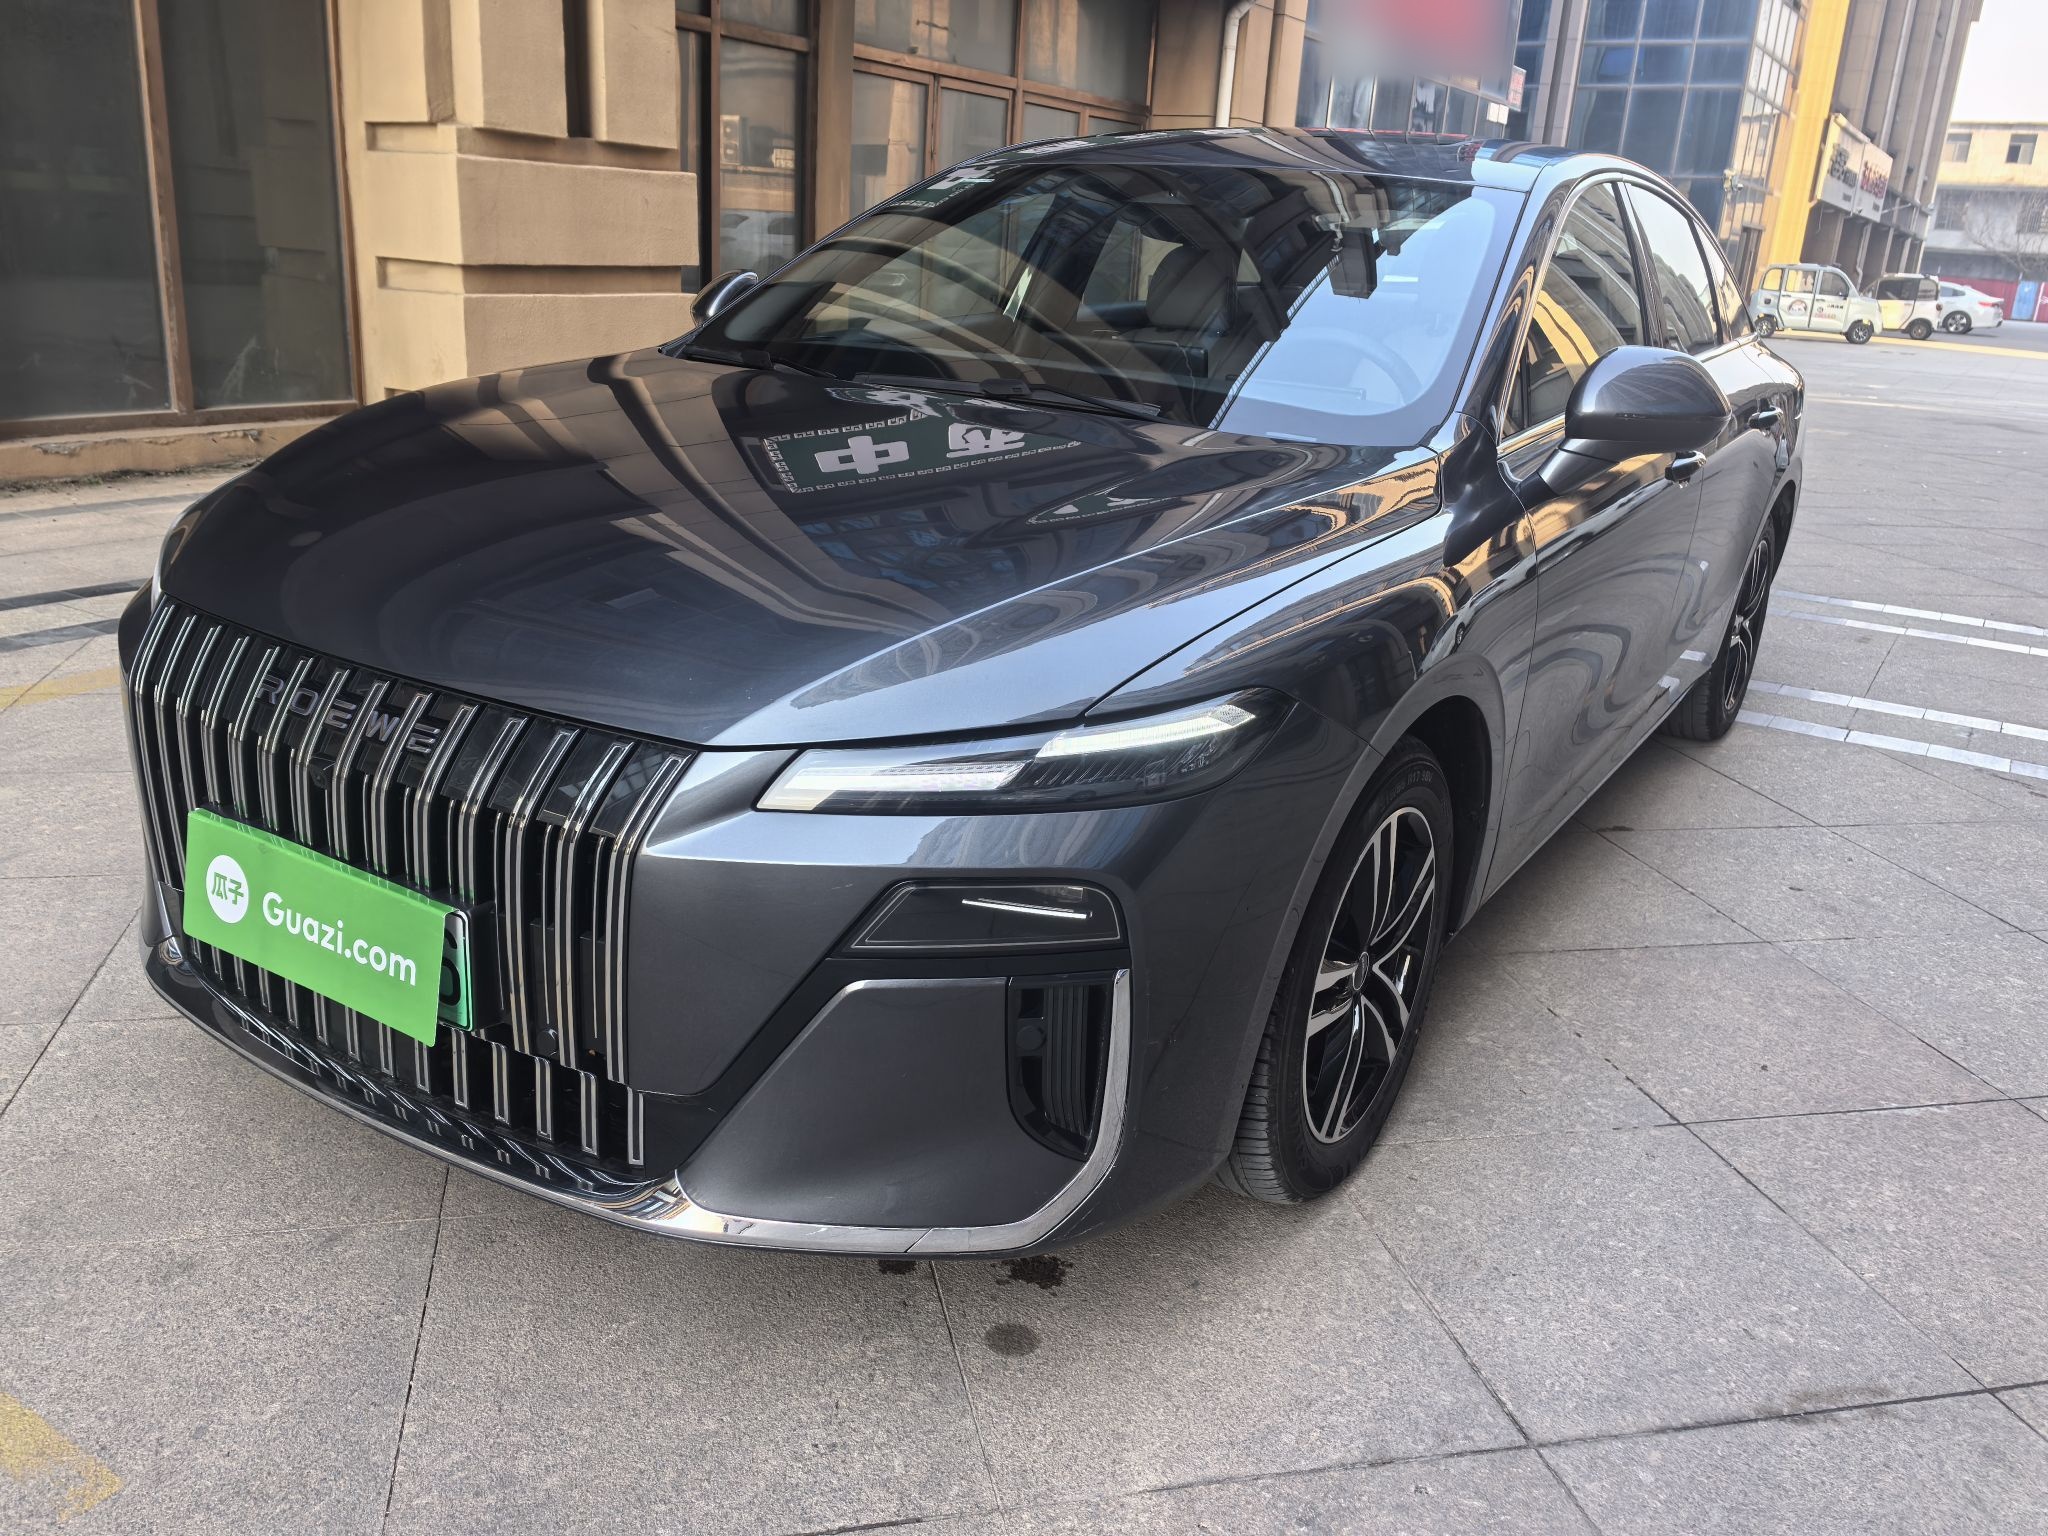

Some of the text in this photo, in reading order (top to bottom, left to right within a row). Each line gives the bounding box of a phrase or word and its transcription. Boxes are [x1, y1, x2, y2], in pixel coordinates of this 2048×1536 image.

[256, 674, 441, 754] ROEWE
[212, 872, 244, 905] 瓜子
[262, 891, 417, 986] Guazi.com
